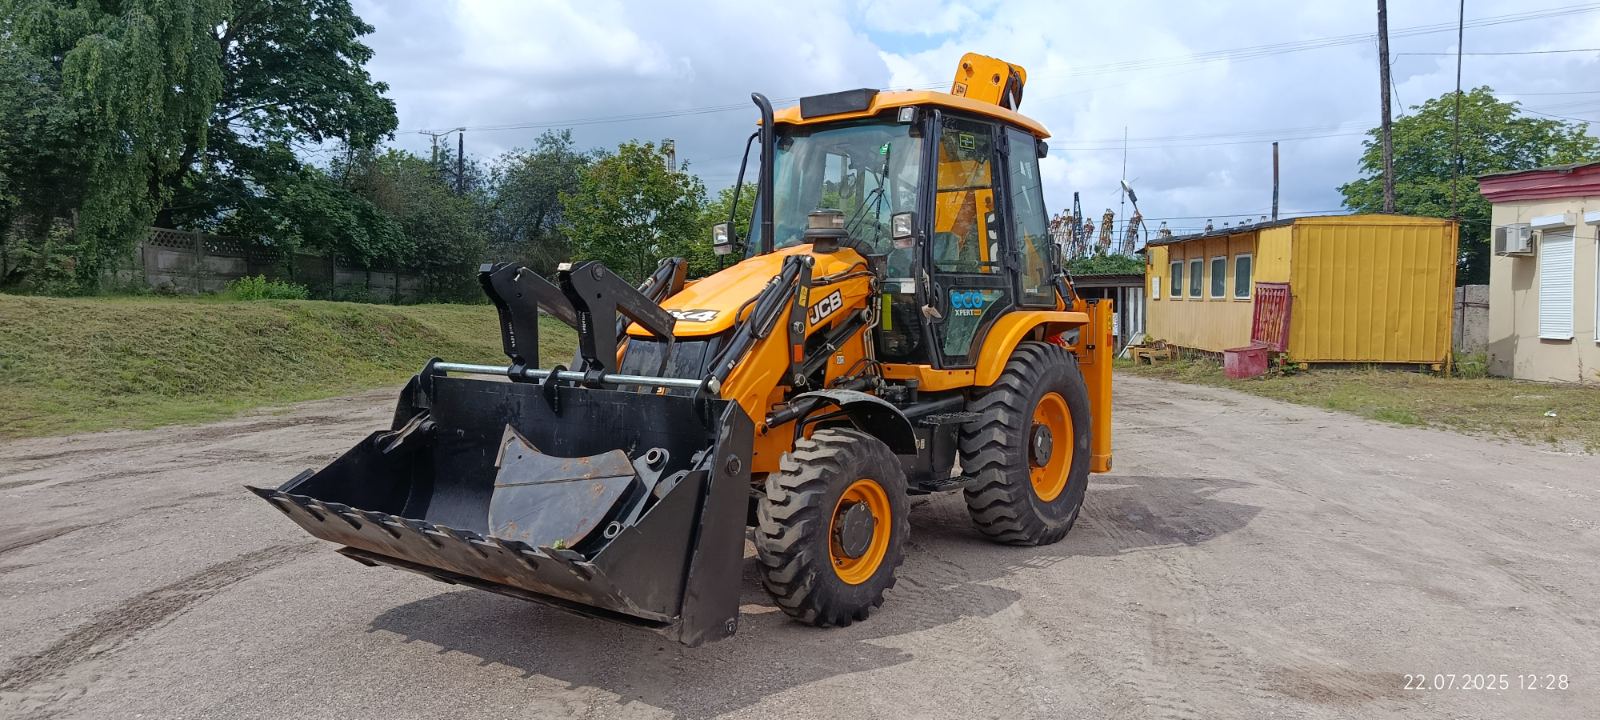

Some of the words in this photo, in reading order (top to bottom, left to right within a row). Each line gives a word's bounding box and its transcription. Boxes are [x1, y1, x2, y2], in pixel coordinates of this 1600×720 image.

[810, 291, 842, 324] JCB
[951, 291, 983, 308] eco
[666, 310, 718, 321] X4
